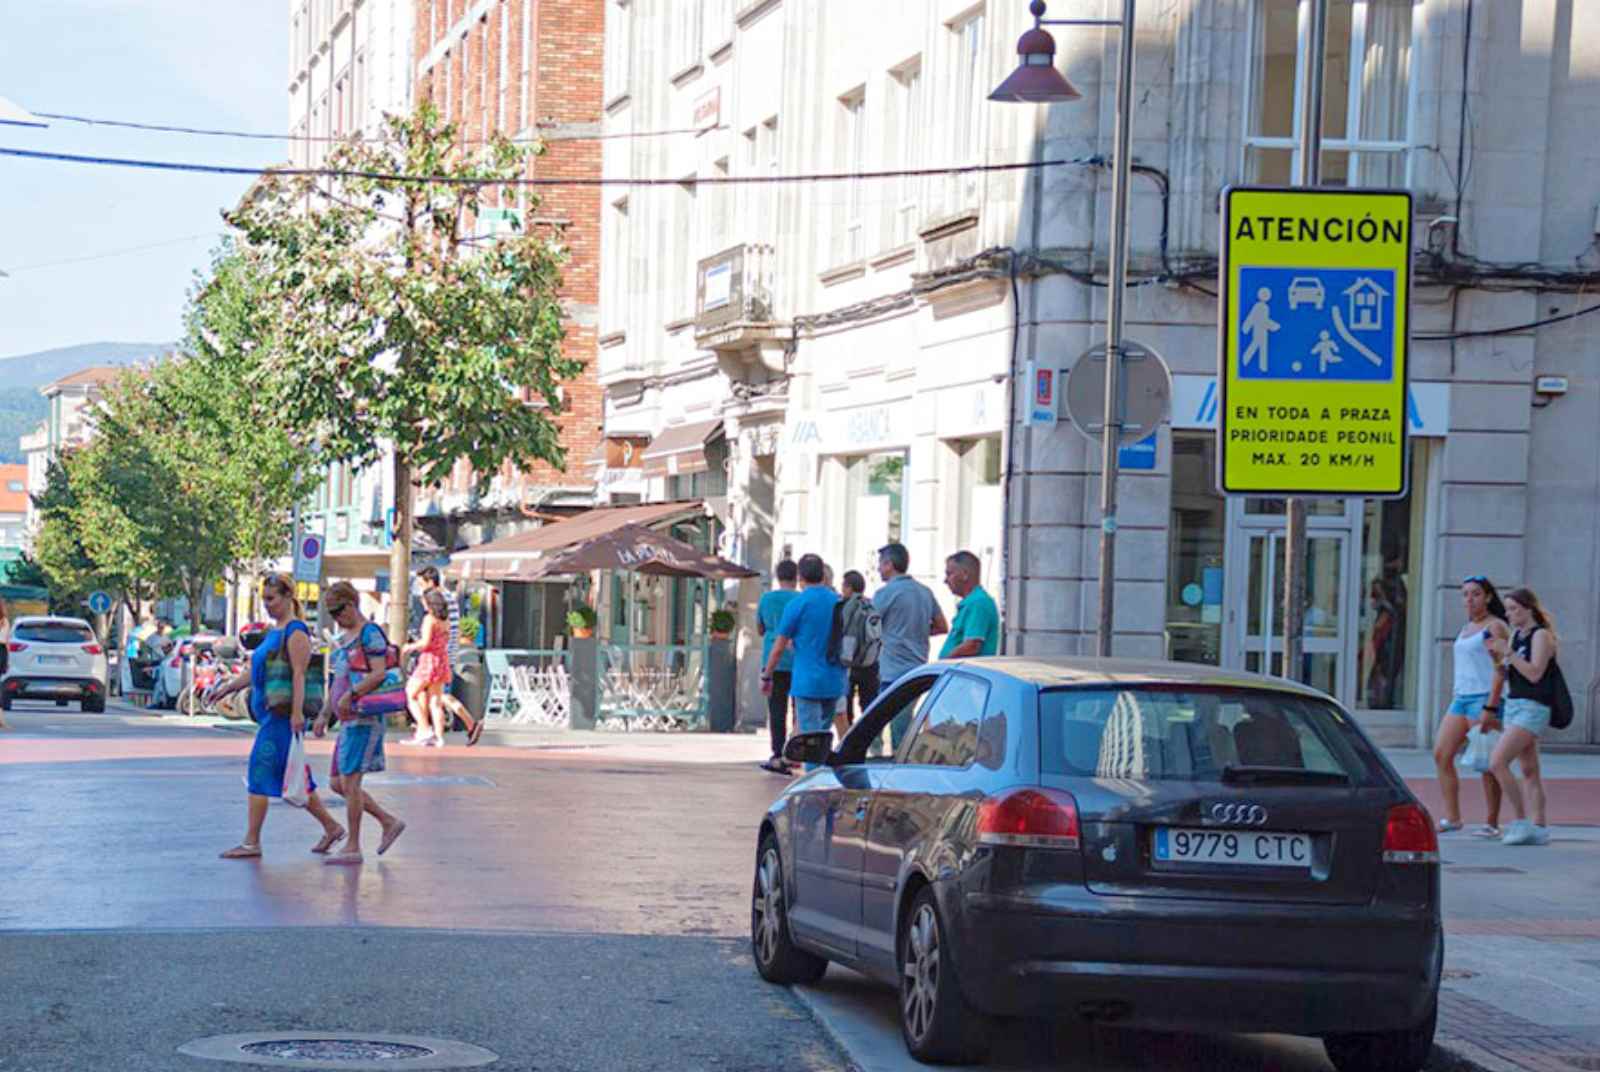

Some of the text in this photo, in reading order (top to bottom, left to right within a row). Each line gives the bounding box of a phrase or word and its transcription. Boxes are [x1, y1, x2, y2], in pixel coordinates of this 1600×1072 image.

[1236, 213, 1403, 243] ATENCIÓN
[1236, 406, 1391, 421] EN TODA A PRAZA
[1231, 429, 1396, 444] PRIORIDADE PEONIL
[1252, 453, 1375, 467] MAX. 20 KM/H
[1175, 832, 1304, 861] 9779 CTC
